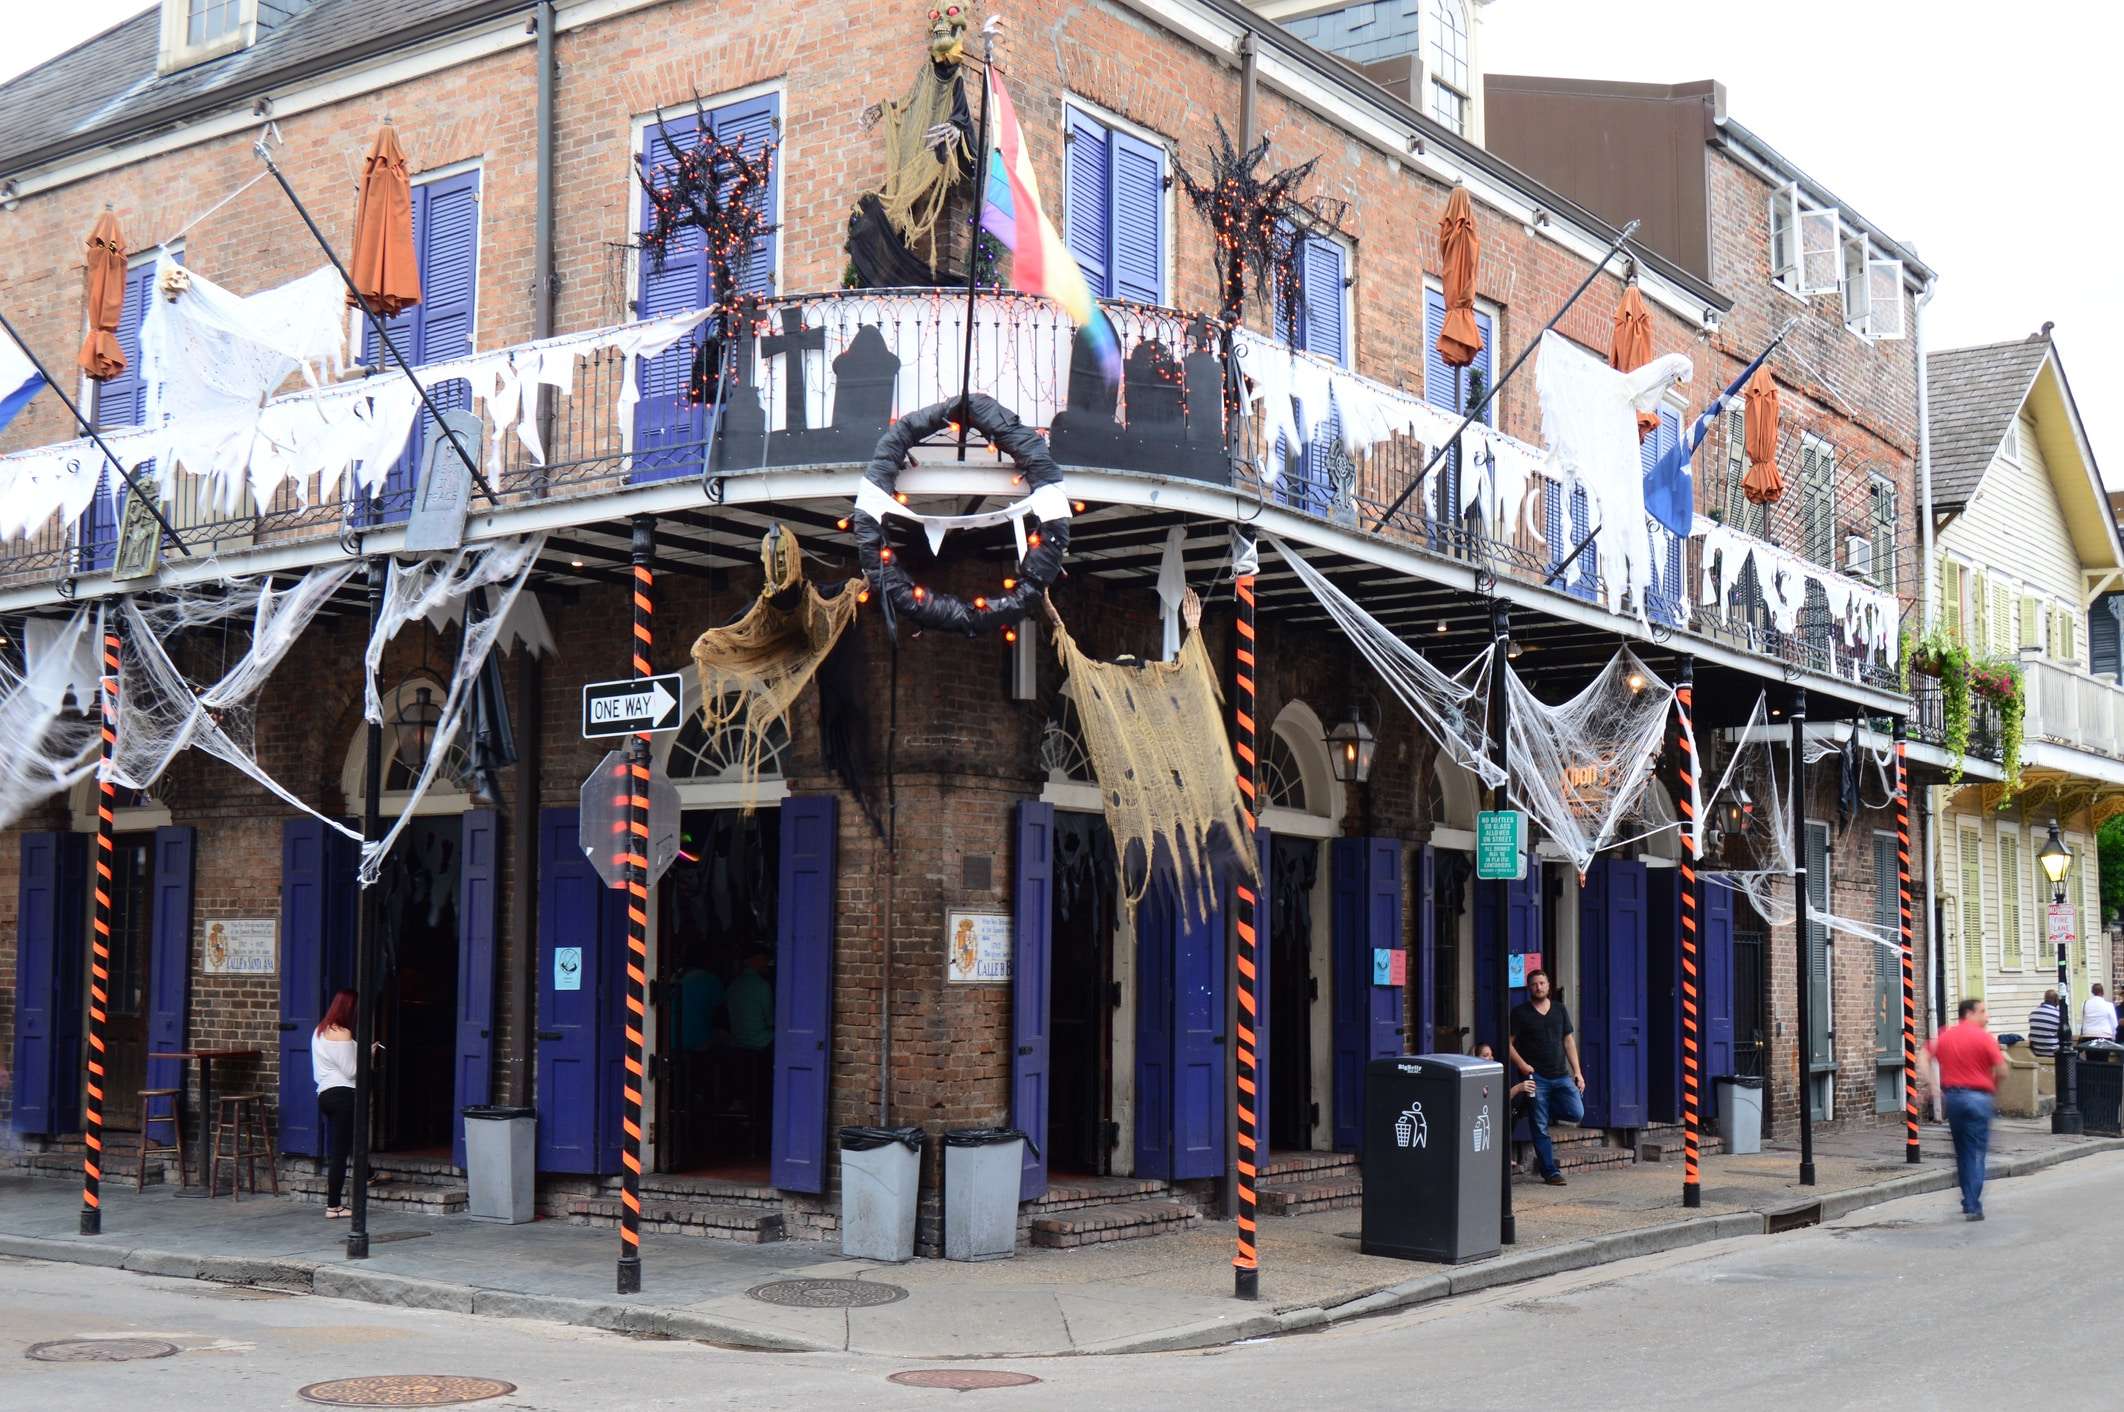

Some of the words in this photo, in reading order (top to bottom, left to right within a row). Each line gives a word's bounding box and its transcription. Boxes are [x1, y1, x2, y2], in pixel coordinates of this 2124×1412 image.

[595, 699, 620, 719] ONE
[625, 695, 651, 716] WAY
[977, 960, 999, 976] CALLE
